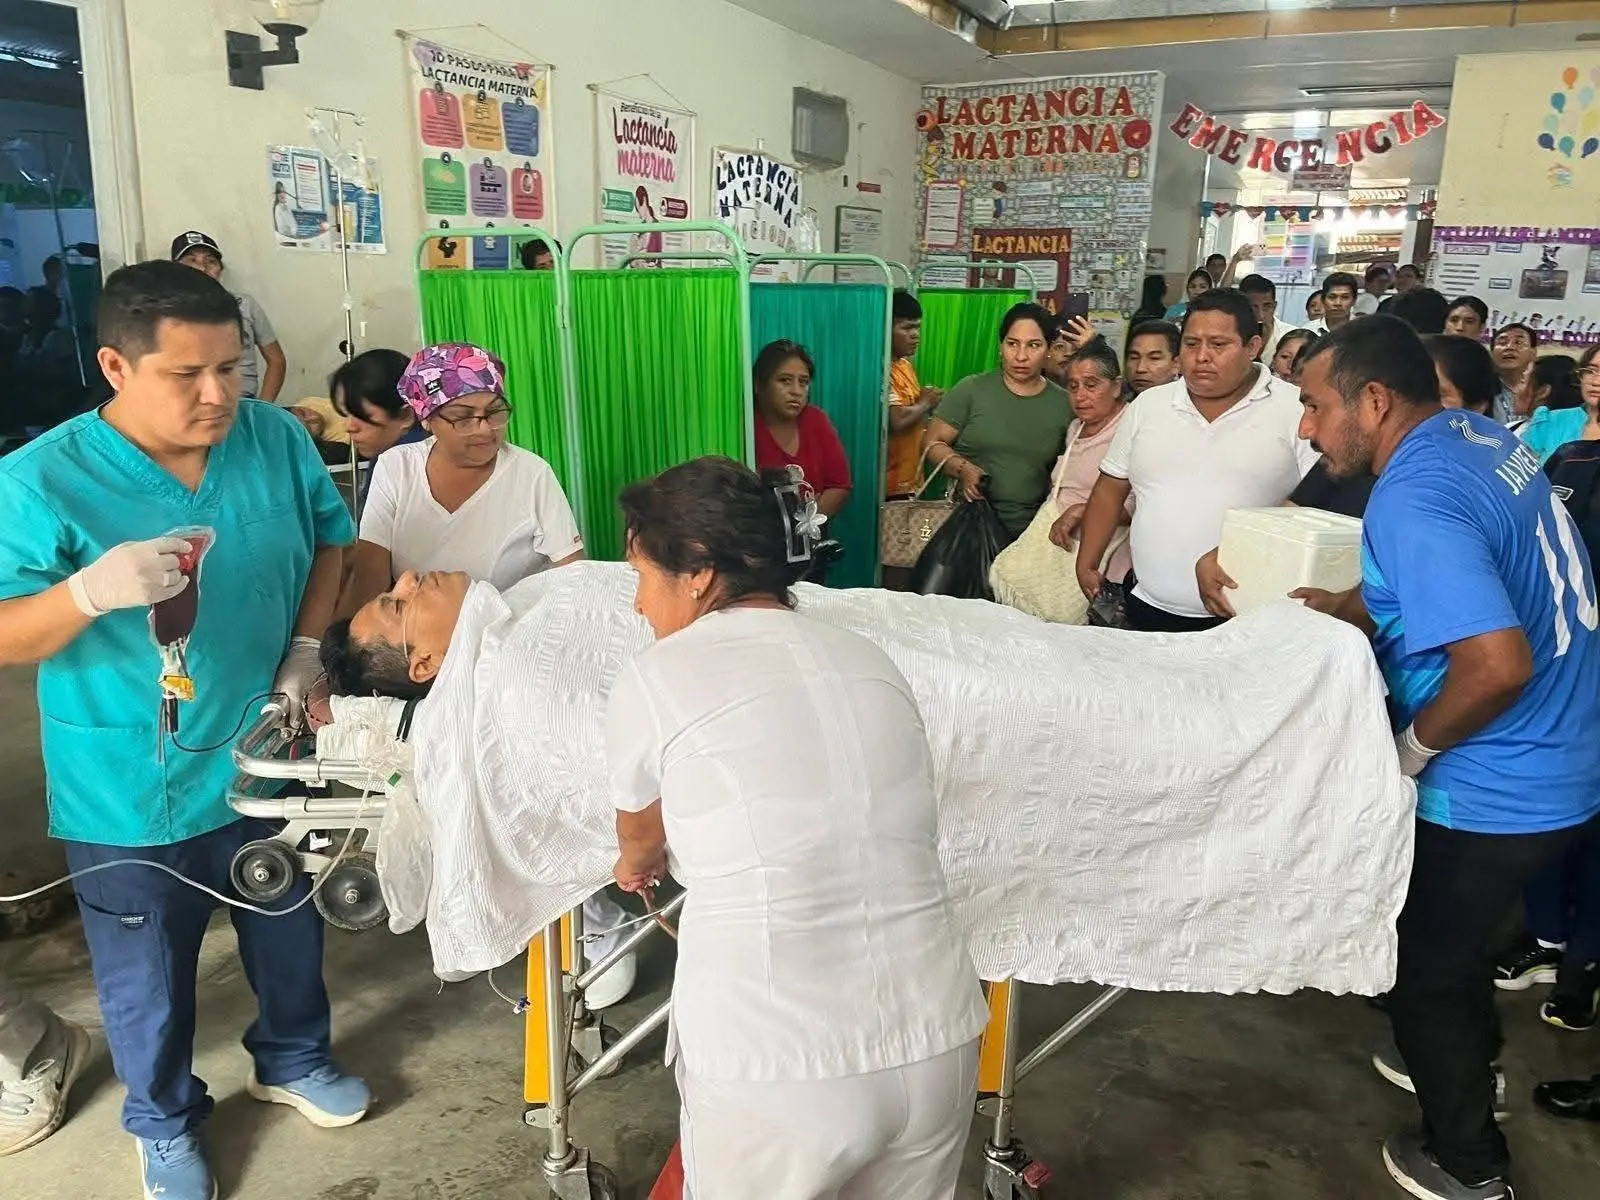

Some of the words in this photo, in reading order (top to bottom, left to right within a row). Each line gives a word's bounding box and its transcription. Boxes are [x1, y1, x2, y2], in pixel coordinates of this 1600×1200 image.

[421, 64, 486, 89] LACTANCIA
[488, 80, 538, 98] MATERNA
[935, 86, 1135, 126] LACTANCIA
[612, 106, 678, 154] Lactancia
[951, 123, 1121, 161] MATERNA
[1168, 100, 1446, 173] EMERGENCIA
[617, 146, 676, 183] materna
[716, 154, 799, 205] LACTANCIA
[720, 177, 792, 228] MATERNA
[972, 234, 1069, 254] LACTANCIA
[1535, 492, 1599, 658] 10
